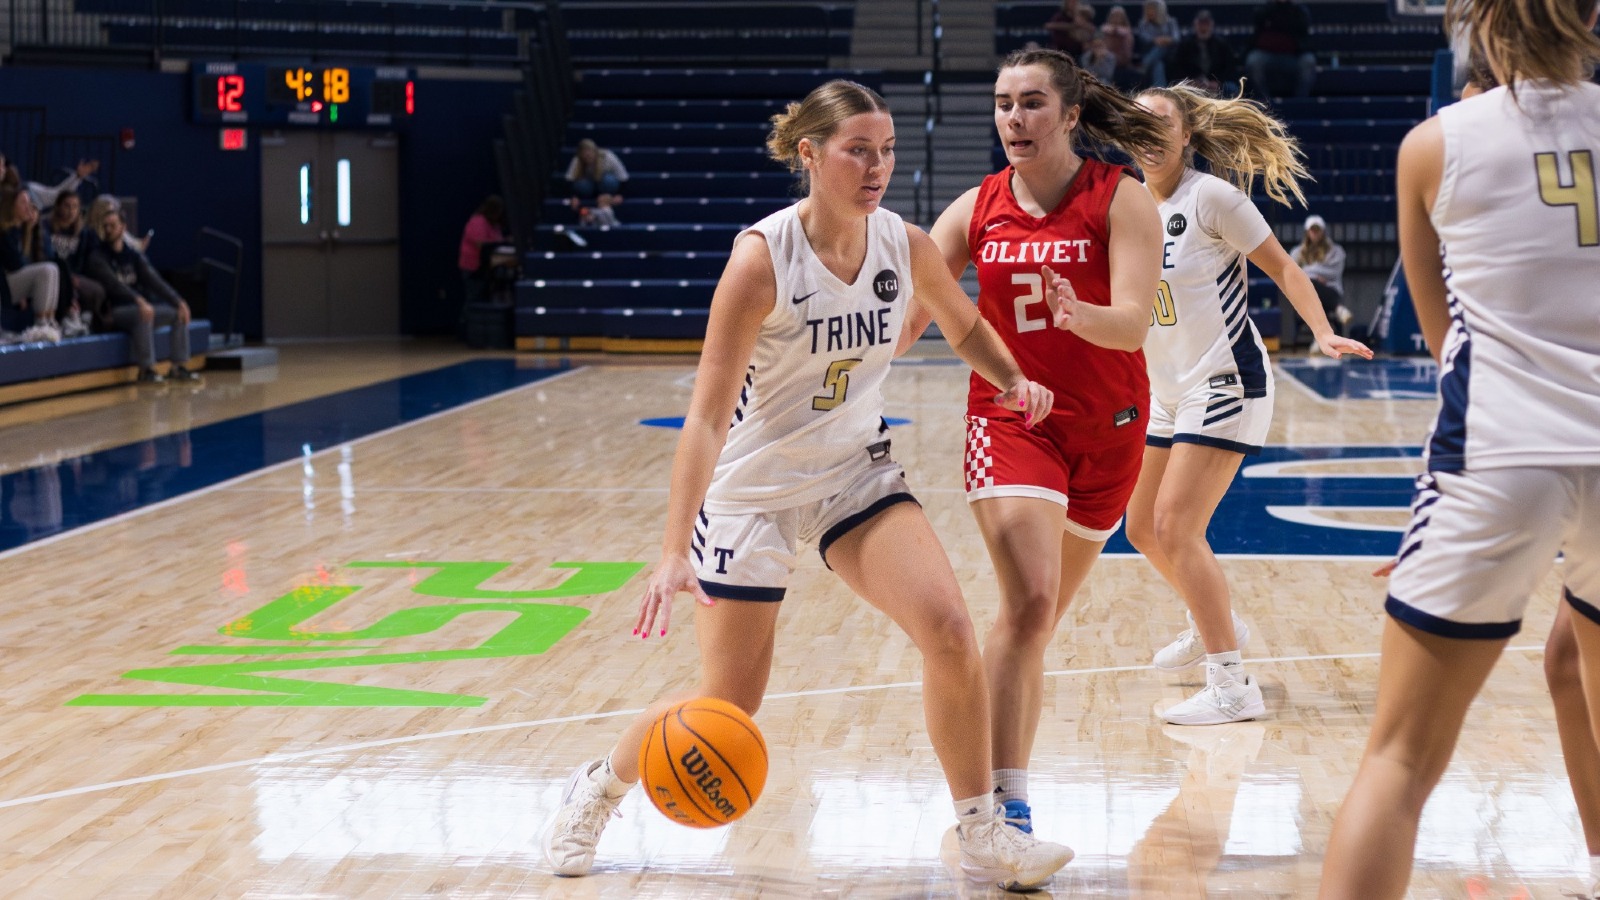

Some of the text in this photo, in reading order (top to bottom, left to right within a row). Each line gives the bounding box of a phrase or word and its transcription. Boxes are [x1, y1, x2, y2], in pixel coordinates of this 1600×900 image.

[217, 74, 245, 112] 12
[285, 67, 350, 103] 4:18
[405, 80, 414, 115] 1
[1533, 149, 1600, 247] 4
[981, 239, 1092, 264] OLIVET
[1011, 273, 1062, 334] 2
[1149, 280, 1177, 326] 0
[806, 307, 892, 355] TRINE
[811, 358, 863, 412] 5
[714, 546, 735, 575] T
[680, 744, 738, 819] Wilson
